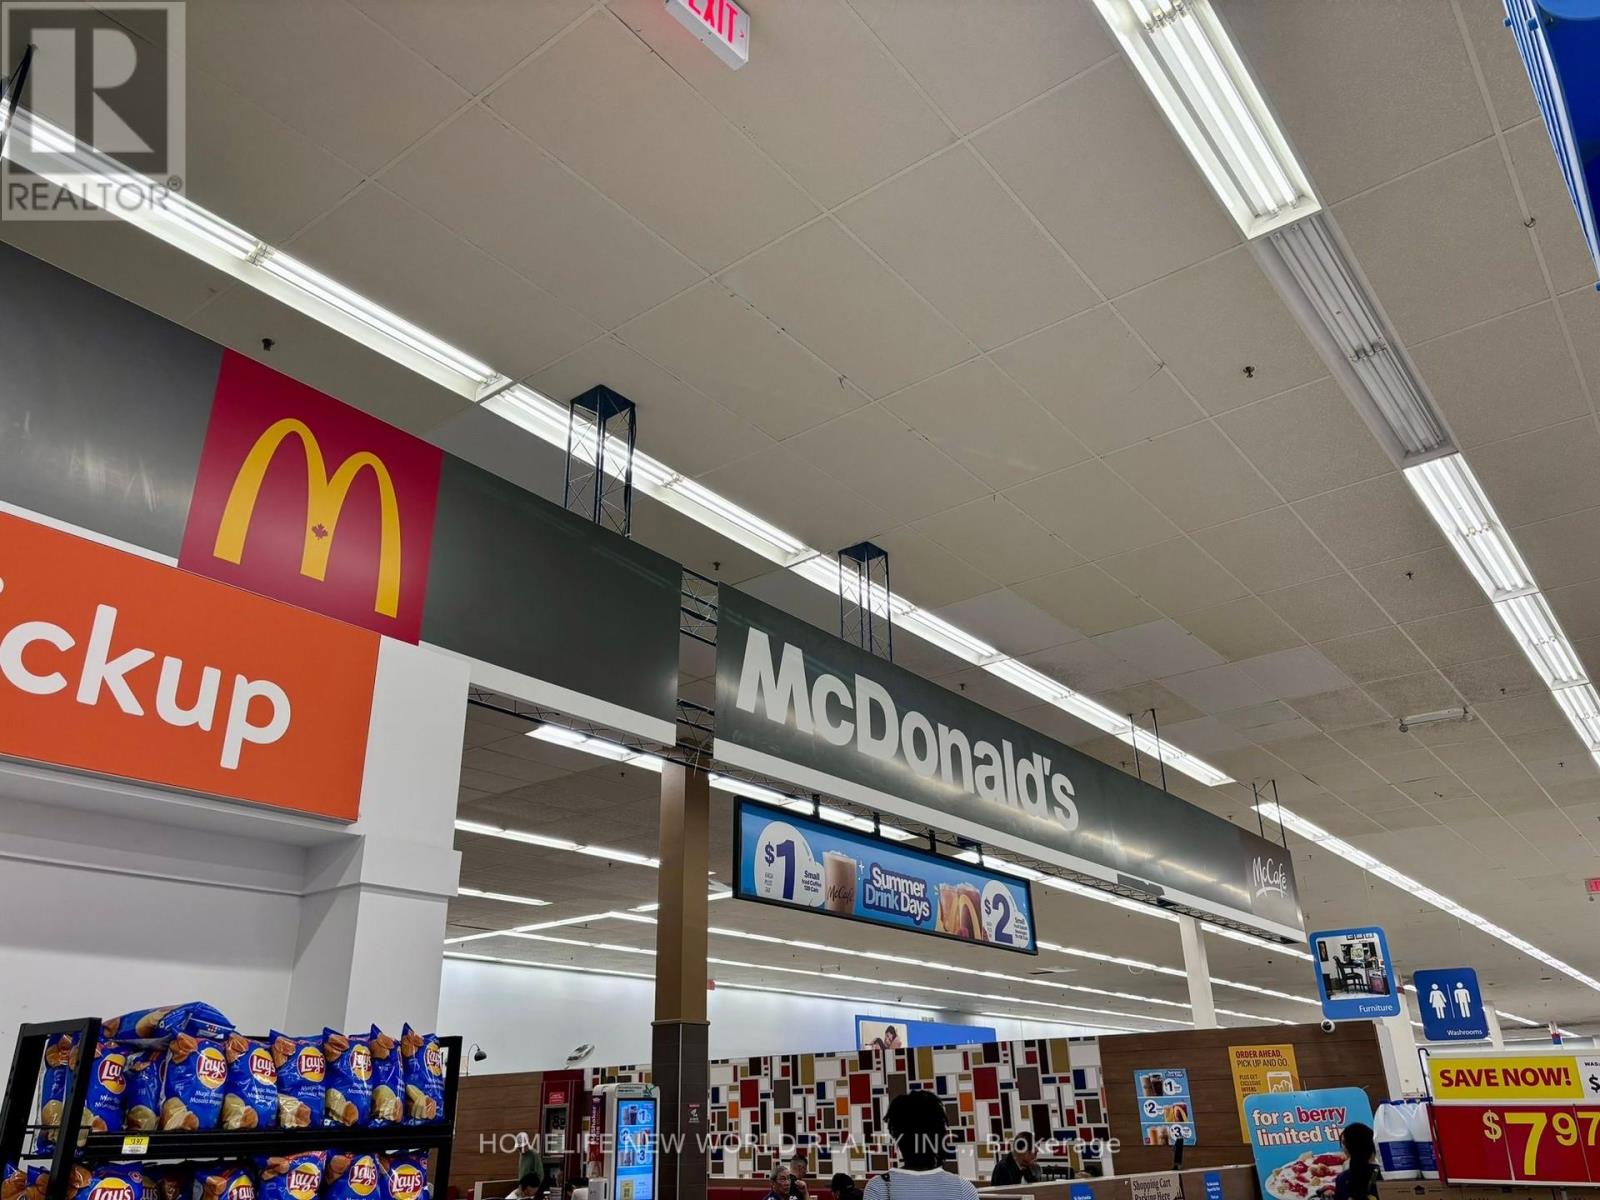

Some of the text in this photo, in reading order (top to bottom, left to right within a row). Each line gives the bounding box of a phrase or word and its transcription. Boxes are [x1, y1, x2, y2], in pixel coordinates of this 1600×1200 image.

[688, 0, 738, 43] XIT
[0, 578, 291, 770] ckup
[736, 627, 1079, 832] McDonald's
[764, 840, 796, 900] $1
[872, 867, 926, 898] Summer
[865, 884, 930, 921] Drink Days
[984, 893, 1013, 944] $2
[1359, 1004, 1393, 1013] Furniture
[1447, 1028, 1483, 1036] Washrooms
[1259, 1050, 1283, 1058] AHEAD,
[1439, 1067, 1572, 1087] SAVE NOW!
[1253, 1106, 1346, 1125] for a berry
[1257, 1126, 1321, 1146] limited
[1133, 1178, 1171, 1191] Shopping Cart
